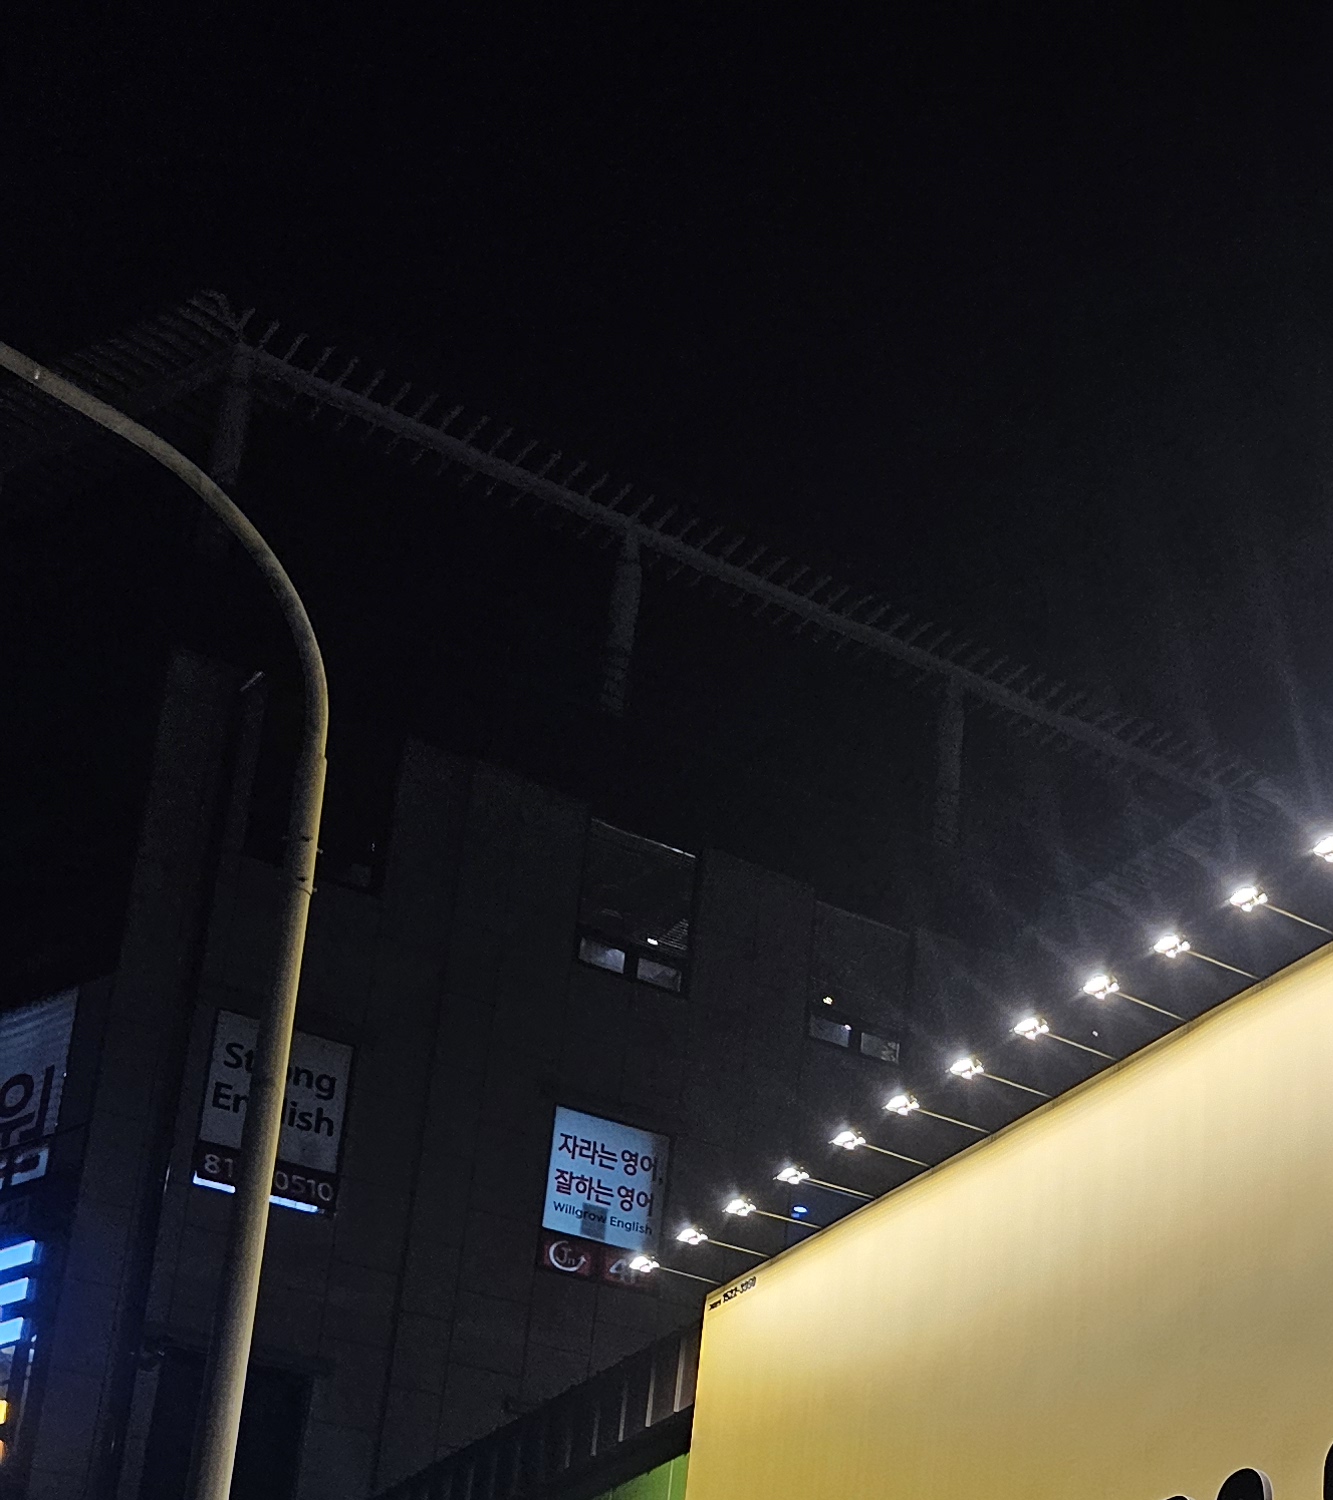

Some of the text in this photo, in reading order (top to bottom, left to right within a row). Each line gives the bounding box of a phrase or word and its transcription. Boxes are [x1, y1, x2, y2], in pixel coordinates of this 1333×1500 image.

[223, 1042, 338, 1101] Stng
[211, 1081, 335, 1137] Enlish
[557, 1132, 618, 1171] 자라는
[554, 1168, 654, 1217] 잘하는 영어
[553, 1201, 653, 1235] Willgrow English
